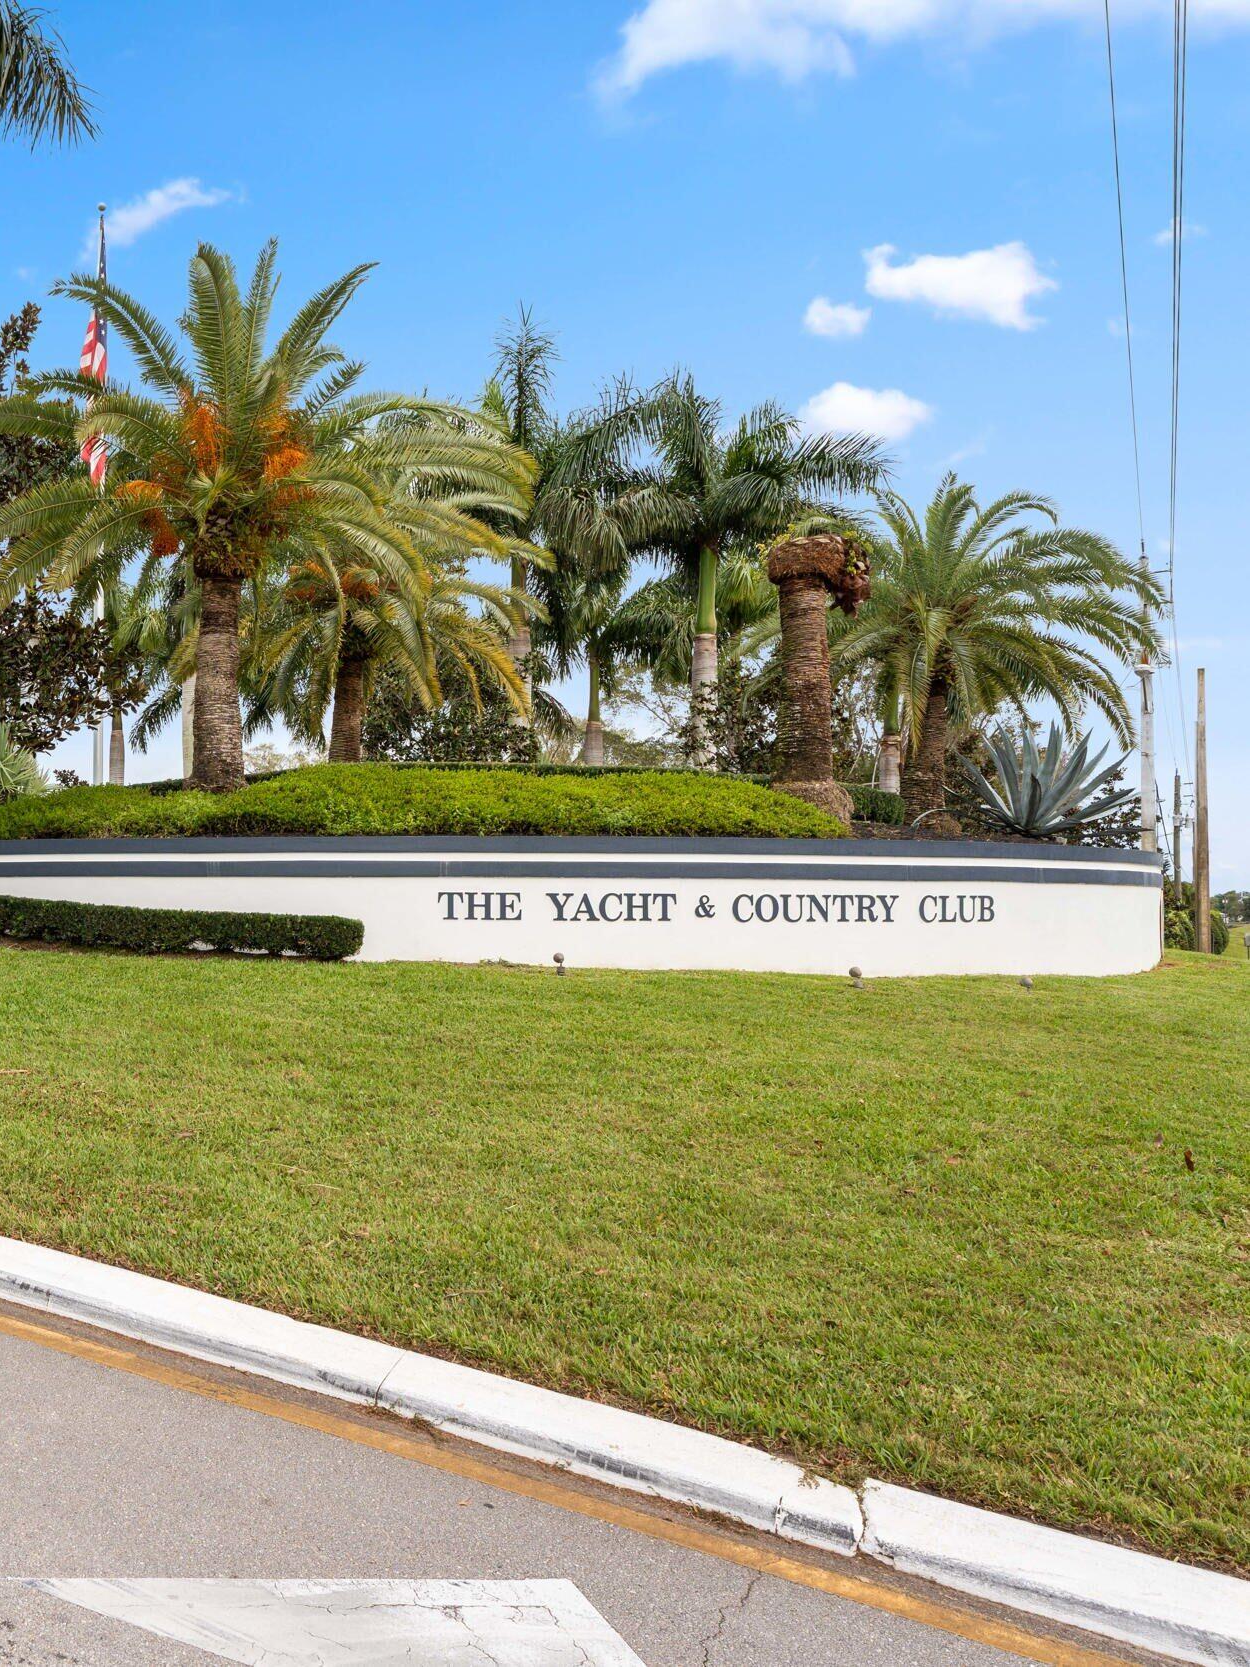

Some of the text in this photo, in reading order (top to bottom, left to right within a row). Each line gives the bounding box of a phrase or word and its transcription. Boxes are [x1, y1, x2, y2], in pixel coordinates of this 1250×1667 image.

[437, 891, 995, 923] THE YACHT & COUNTRY CLUB
